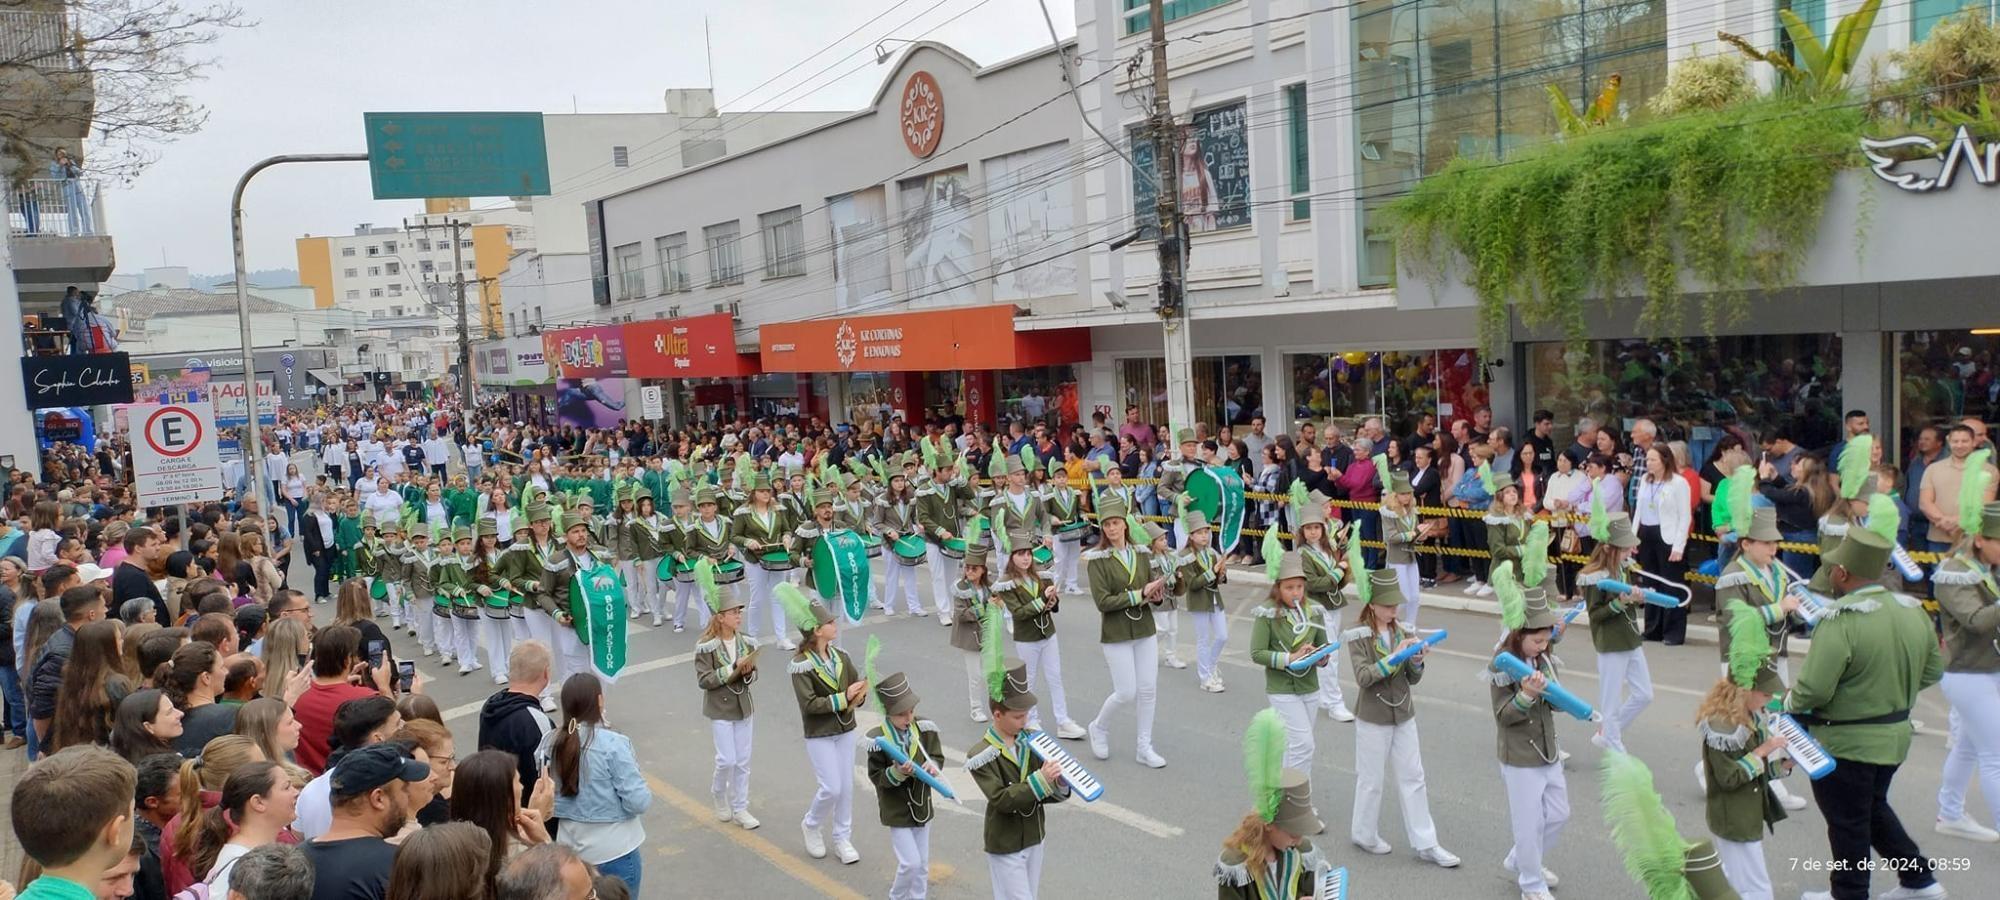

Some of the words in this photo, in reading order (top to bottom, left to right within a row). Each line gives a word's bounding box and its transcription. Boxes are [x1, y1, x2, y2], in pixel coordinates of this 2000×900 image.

[913, 105, 928, 124] KR
[663, 335, 688, 356] Ultra
[220, 383, 270, 398] Adlu
[285, 366, 295, 400] ÓTICA
[162, 417, 185, 447] E
[157, 463, 197, 472] DESCARGA
[160, 457, 187, 465] CARGA
[848, 552, 859, 574] BOM
[604, 594, 614, 621] BOM
[606, 624, 614, 669] PASTOR
